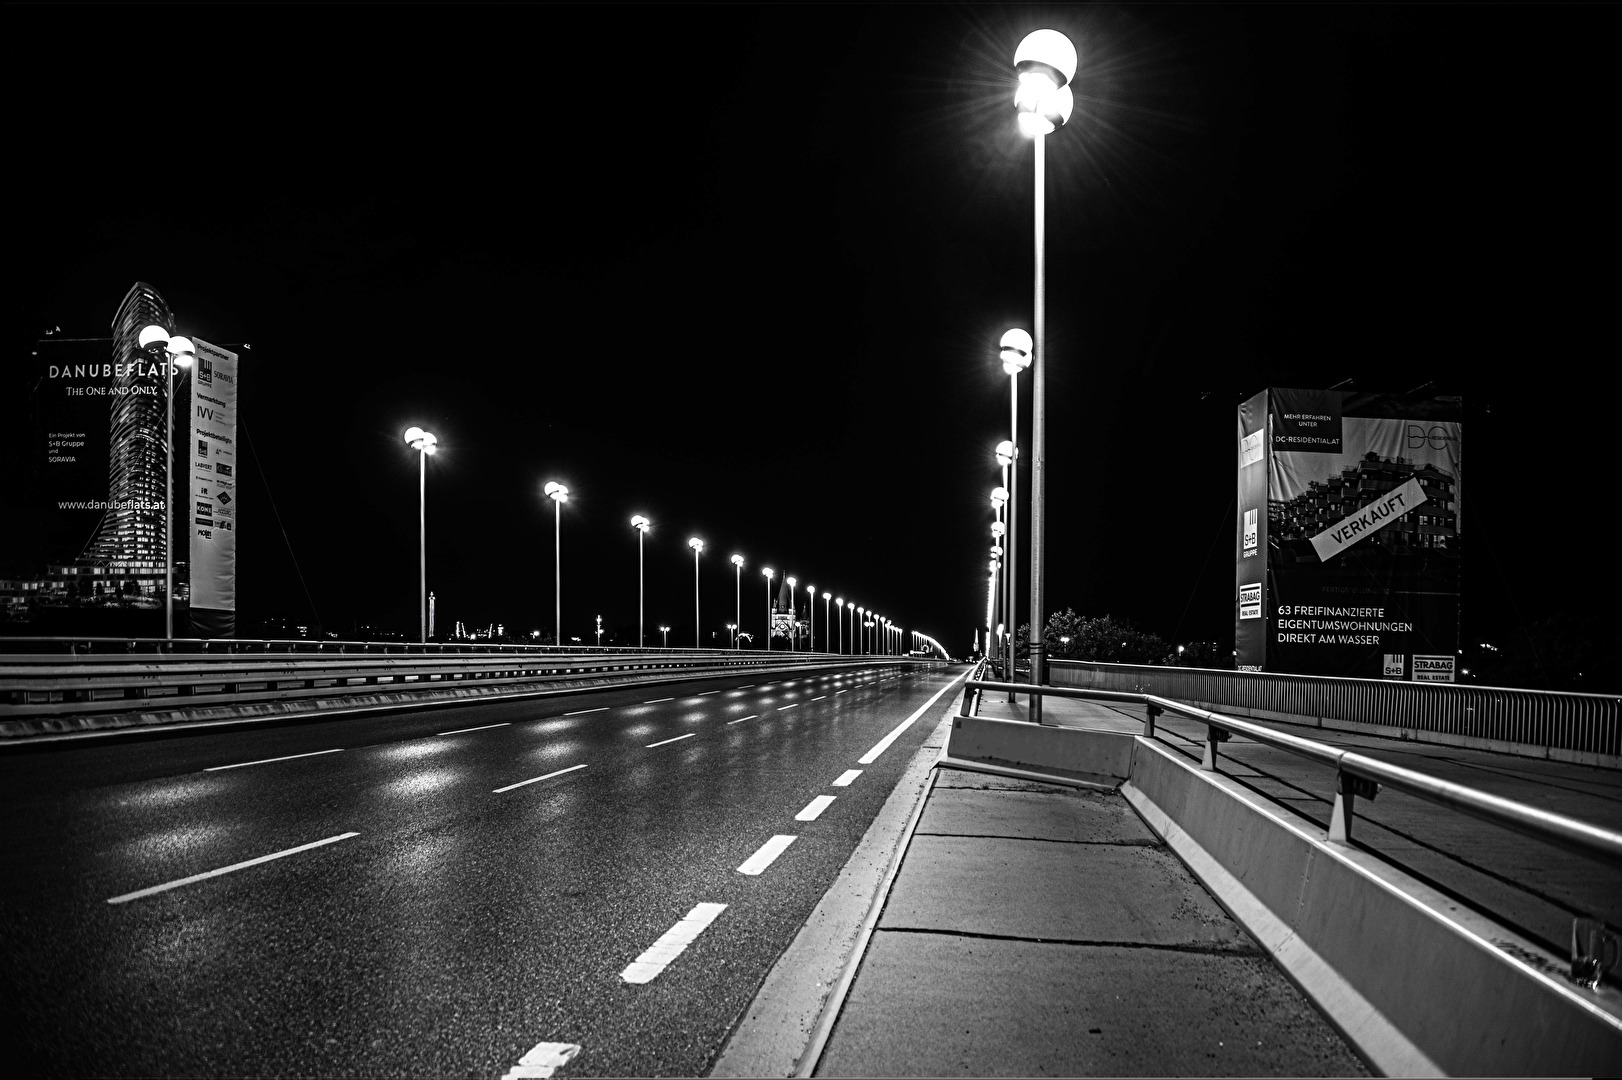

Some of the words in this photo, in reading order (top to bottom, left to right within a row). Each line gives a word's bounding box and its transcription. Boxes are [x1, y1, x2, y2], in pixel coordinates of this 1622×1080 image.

[49, 362, 179, 378] DANUBEFLATS
[199, 370, 211, 382] S+B
[86, 386, 106, 396] ONE
[197, 405, 214, 421] IVV
[1301, 413, 1331, 421] ERFAHREN
[61, 440, 85, 448] Gruppe
[1275, 435, 1340, 445] DC-RESIDENTIAL.AT
[58, 499, 166, 510] www.danubeflats.at
[1330, 493, 1405, 544] VERKAUFT
[1245, 532, 1256, 547] S+B
[1240, 591, 1260, 603] STRABAG
[1278, 605, 1292, 615] 63
[1294, 605, 1385, 618] FREIFINANZIERTE
[1278, 619, 1413, 632] EIGENTUMSWOHNUNGEN
[1278, 633, 1316, 643] DIREKT
[1318, 635, 1336, 644] AM
[1338, 635, 1380, 645] WASSER
[1385, 667, 1402, 675] S+B
[1414, 661, 1453, 669] STRABAG
